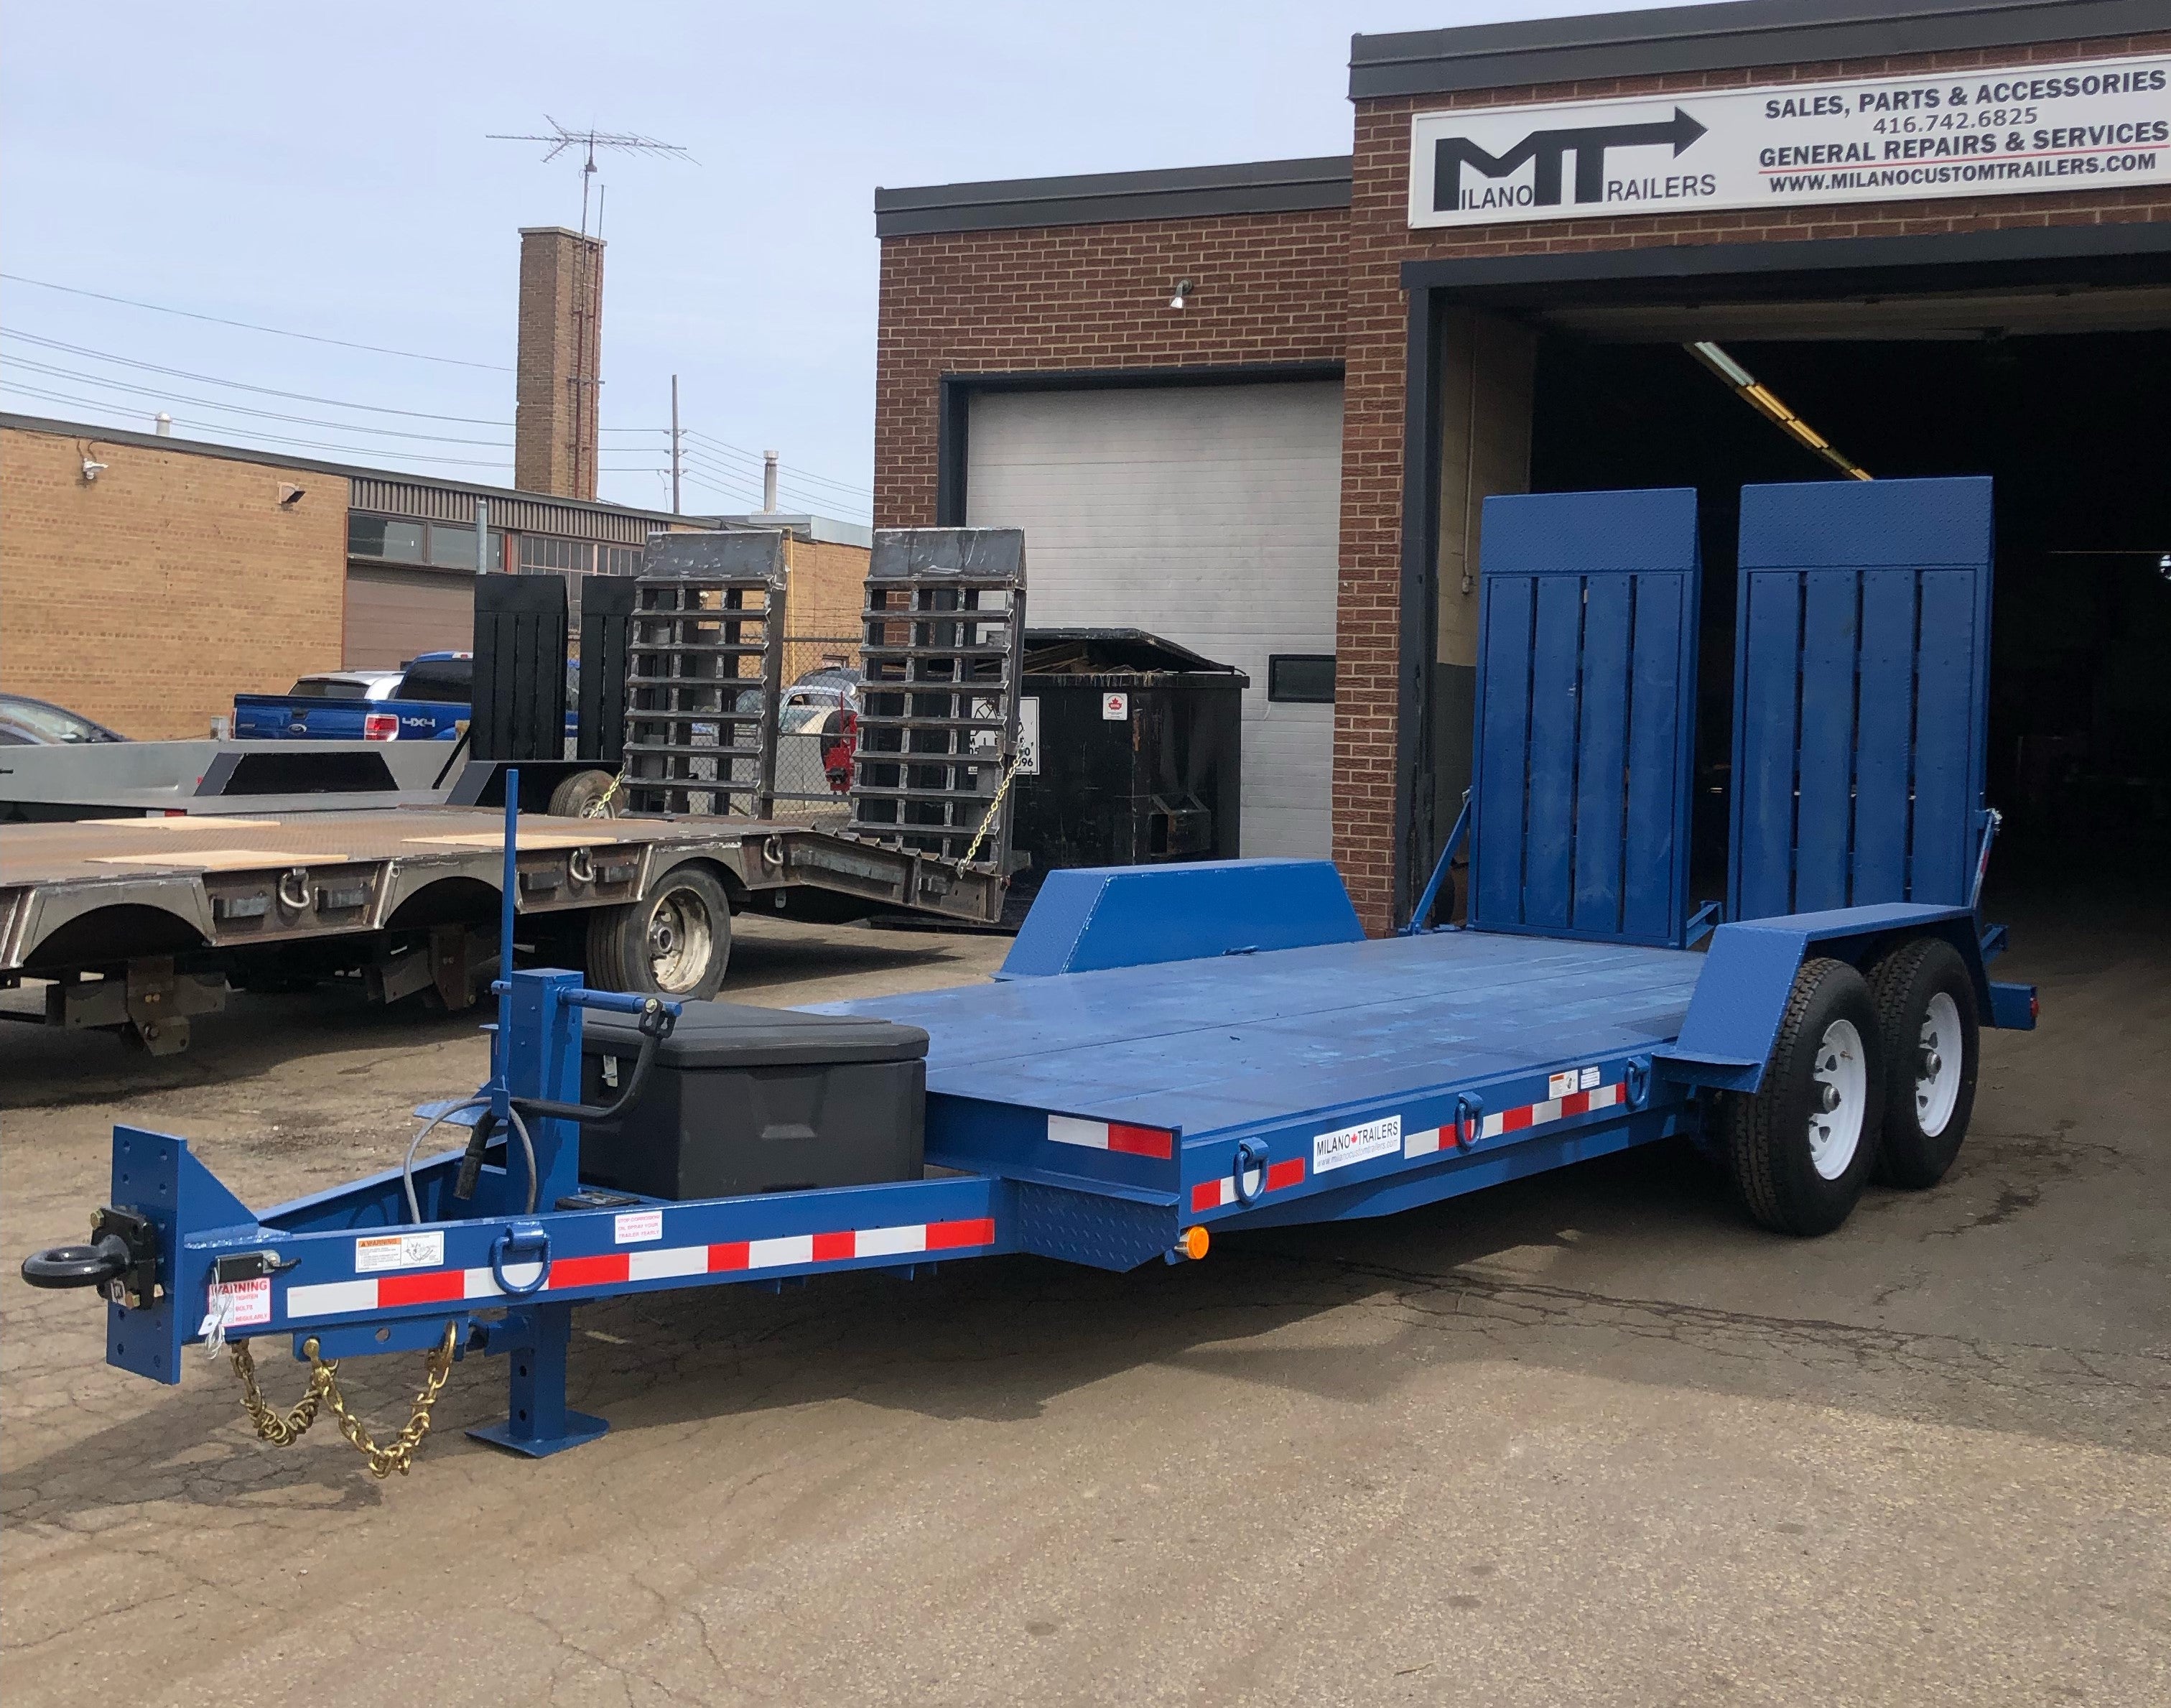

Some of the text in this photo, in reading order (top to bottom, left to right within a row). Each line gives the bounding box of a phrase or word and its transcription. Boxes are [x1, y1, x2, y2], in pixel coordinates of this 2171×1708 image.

[1765, 69, 2167, 119] SALES, PARTS & ACCESSORIES
[1872, 106, 2038, 135] 416.742.6825
[1759, 120, 2170, 167] GENERAL REPAIRS & SERVICES
[1769, 152, 2157, 193] WWW.MILANOCUSTOMTRAILERS.COM
[1316, 1120, 1398, 1157] MILANO TRAILERS
